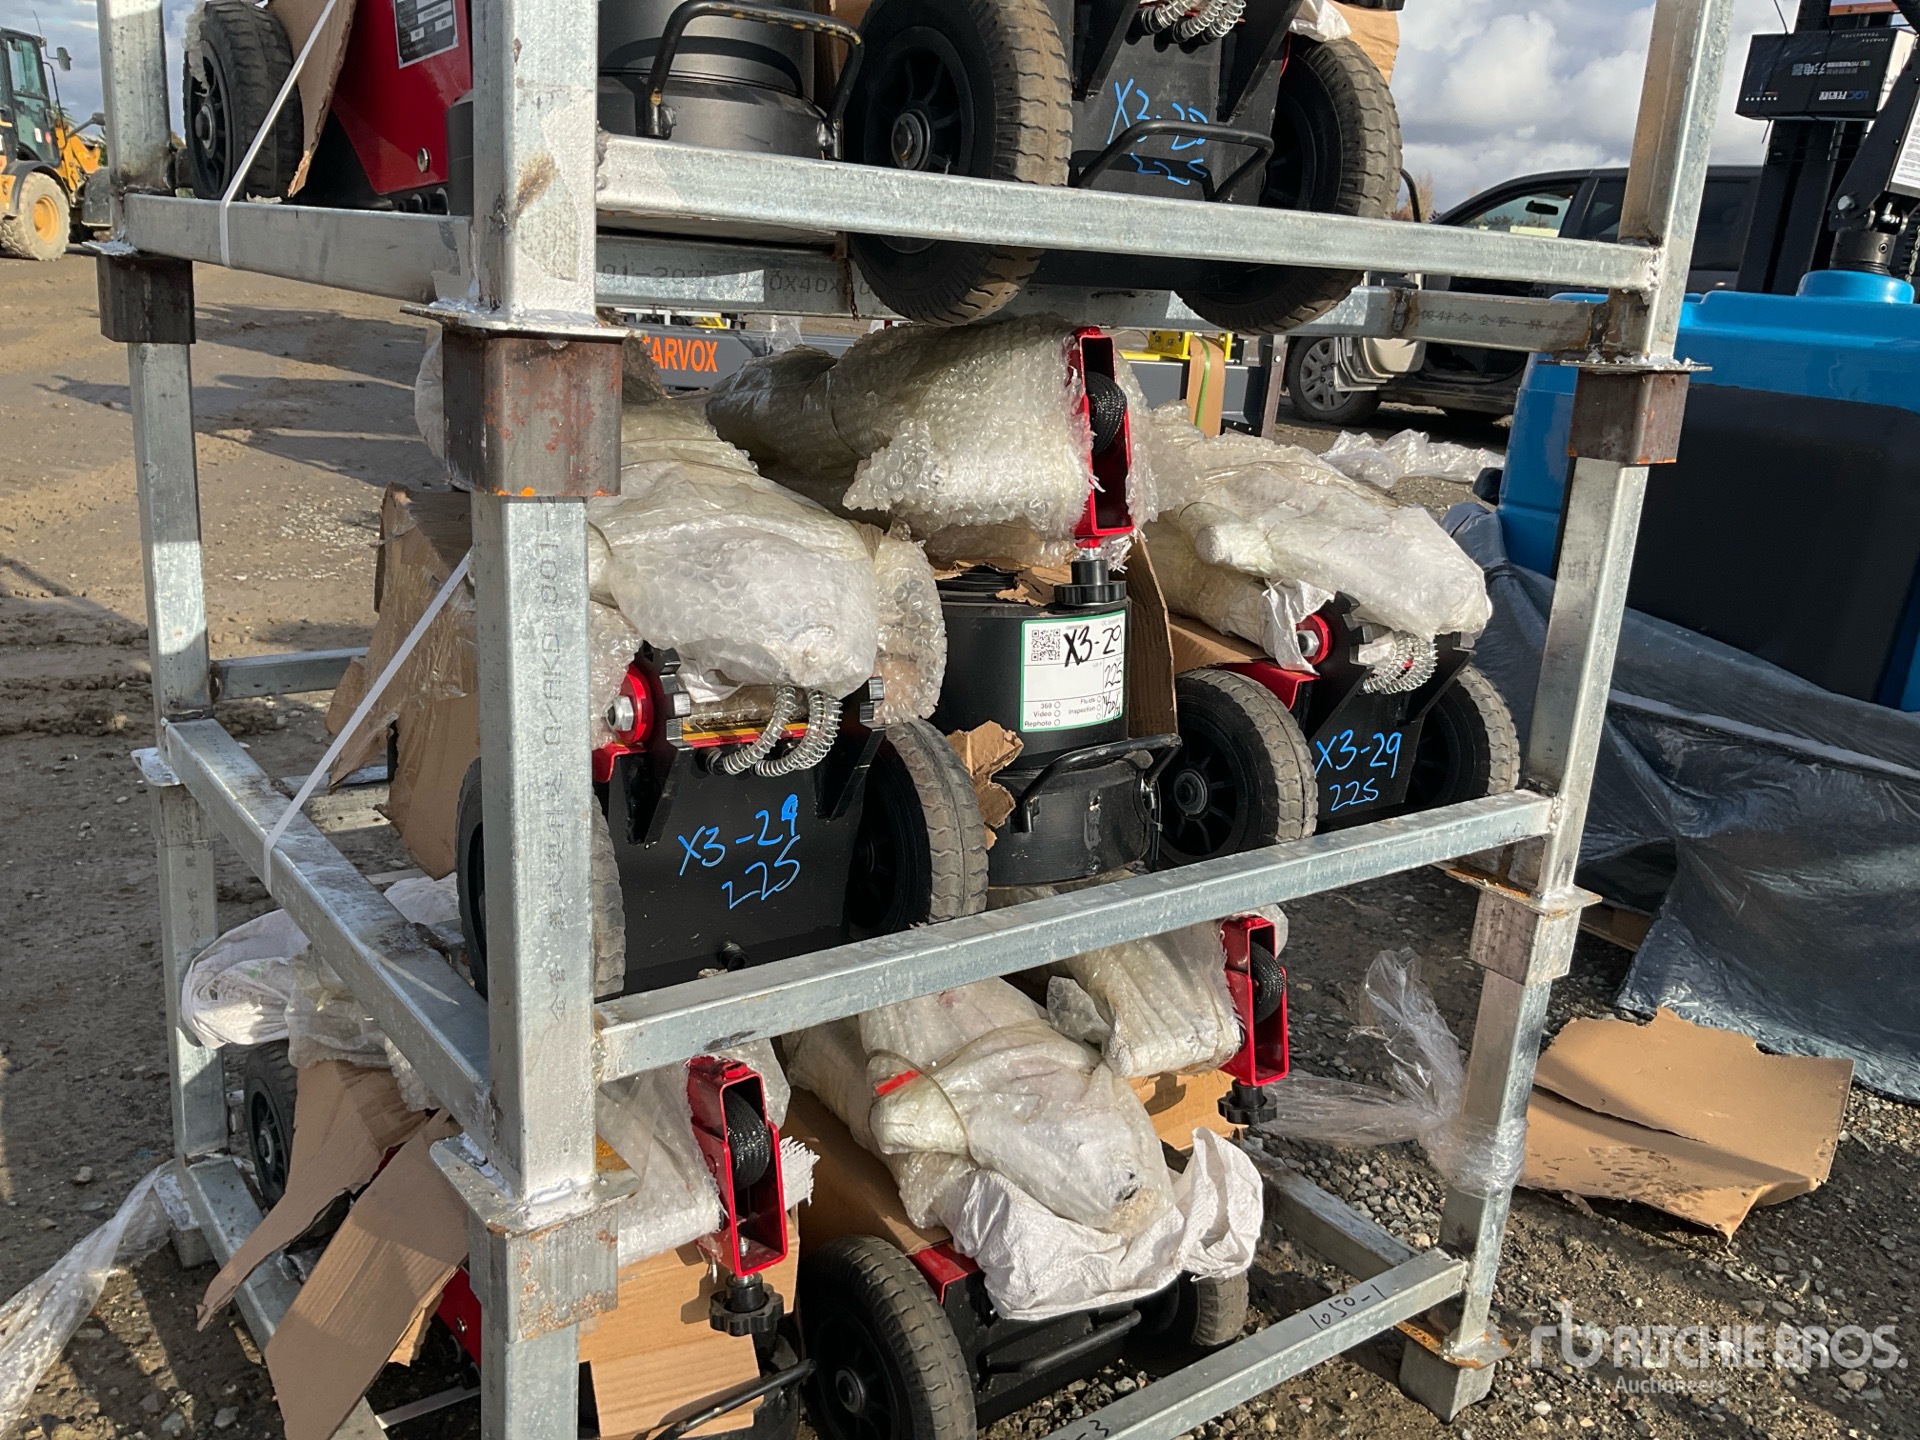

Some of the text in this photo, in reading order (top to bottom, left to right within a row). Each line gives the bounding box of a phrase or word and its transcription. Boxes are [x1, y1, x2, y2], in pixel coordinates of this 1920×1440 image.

[642, 336, 718, 372] ARVOX
[1025, 720, 1052, 728] Rephoto
[1033, 710, 1052, 718] Video
[1315, 729, 1402, 778] X3-29
[1329, 777, 1379, 811] 225
[677, 793, 799, 876] X3-29
[721, 834, 801, 909] 225
[1309, 1284, 1388, 1330] 1050-1
